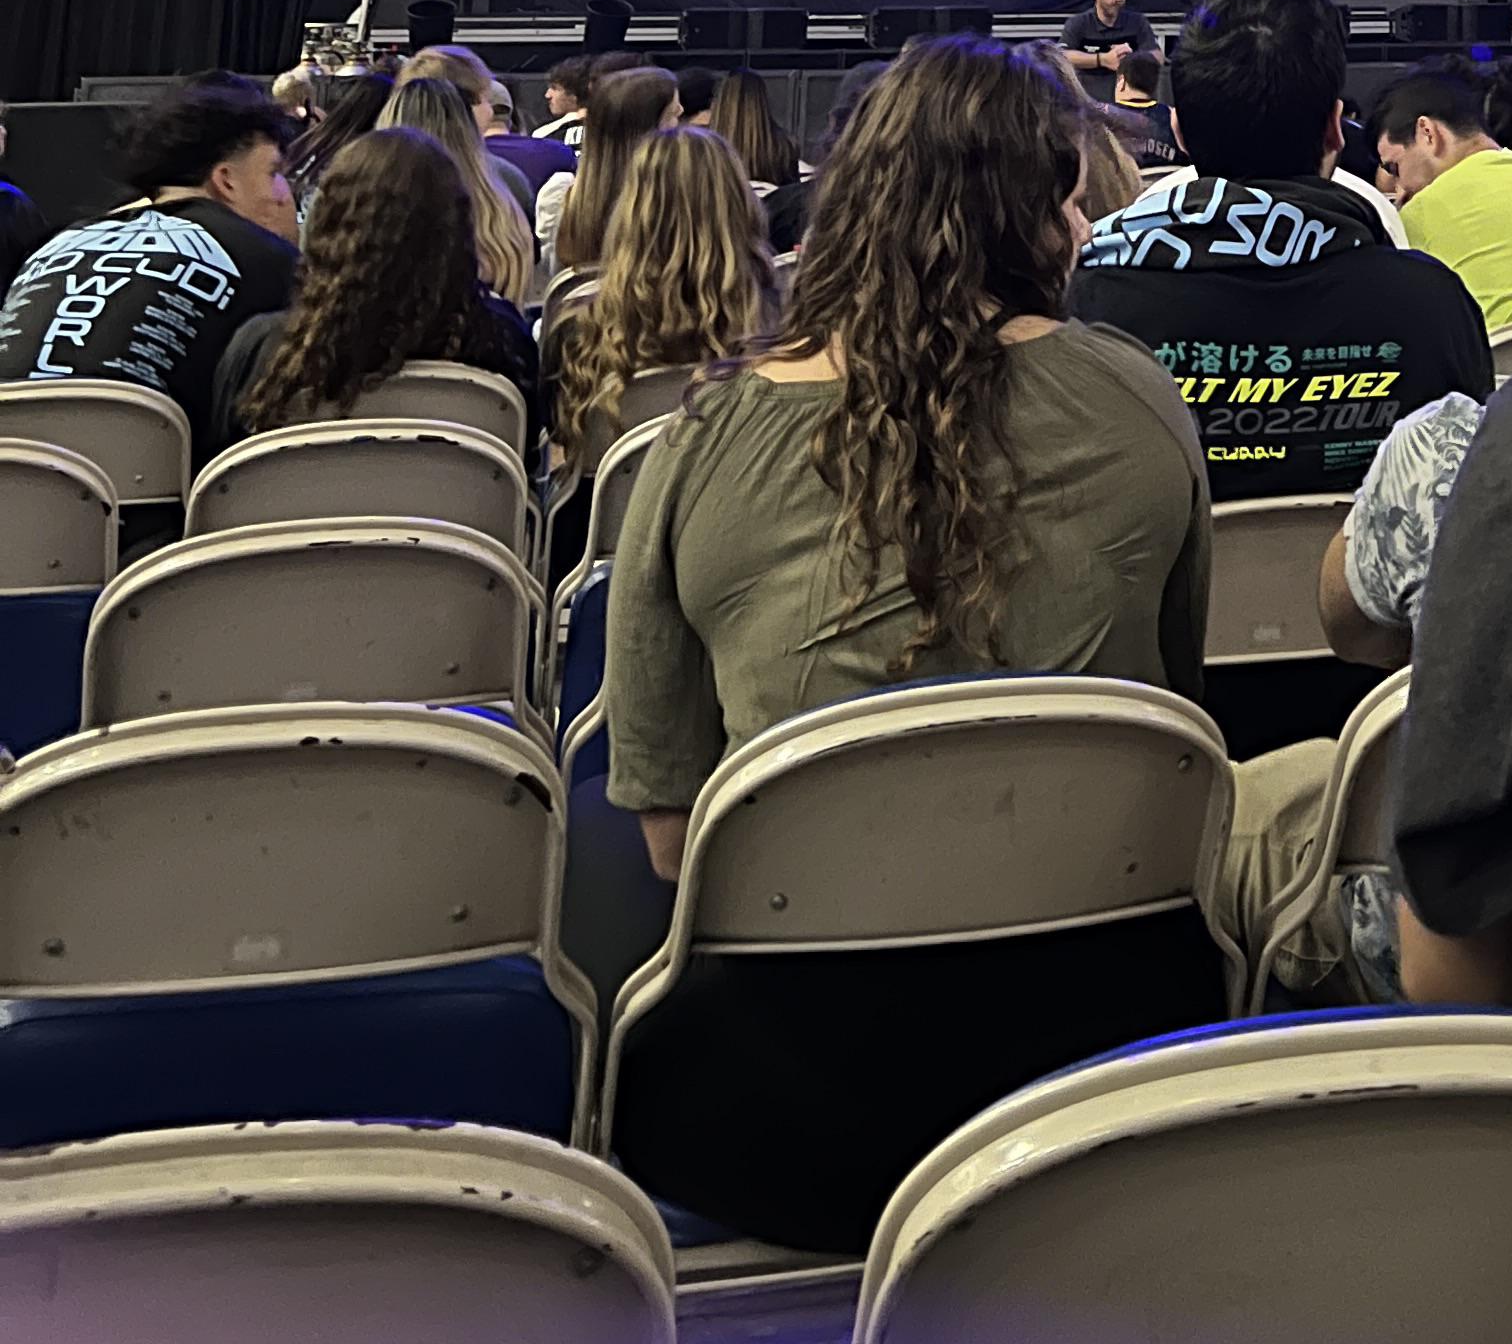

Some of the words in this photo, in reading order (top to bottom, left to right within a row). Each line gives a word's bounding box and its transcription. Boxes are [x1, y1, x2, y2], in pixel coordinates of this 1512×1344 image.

[28, 273, 132, 380] WORL
[1226, 377, 1300, 404] MY
[1299, 371, 1401, 402] EYEZ
